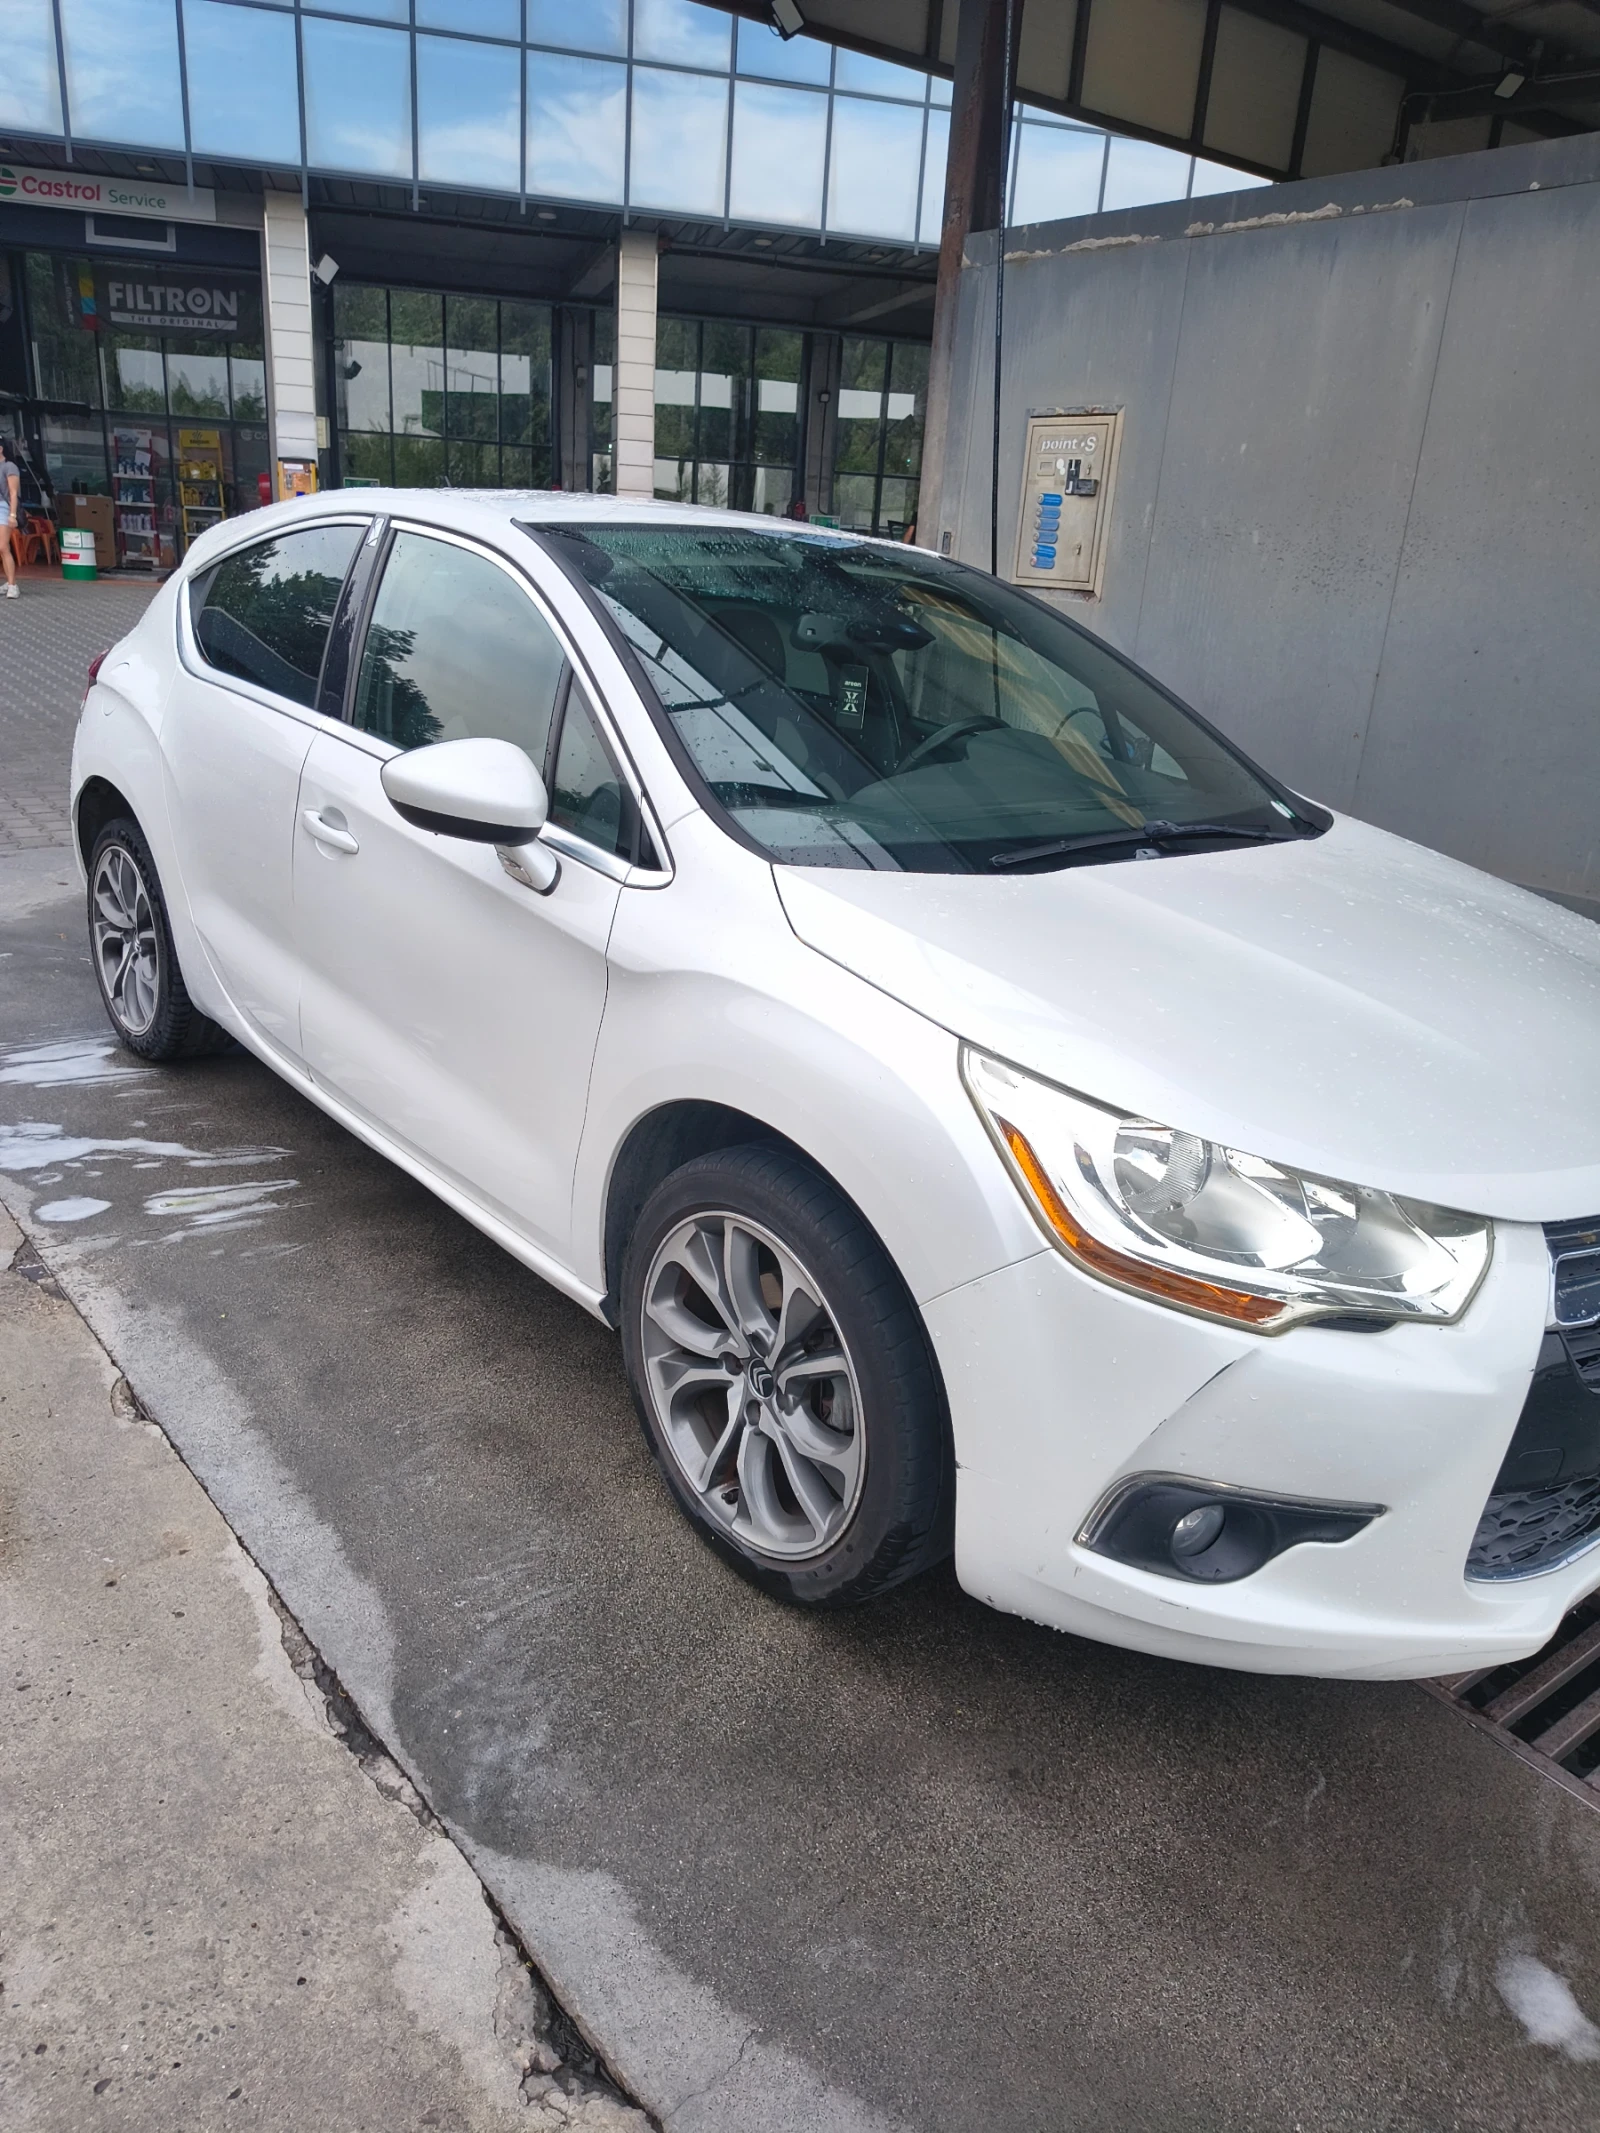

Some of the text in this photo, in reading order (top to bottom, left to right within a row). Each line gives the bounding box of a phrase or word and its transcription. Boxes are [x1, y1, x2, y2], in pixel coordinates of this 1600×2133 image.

[21, 175, 167, 209] Castrol Service
[108, 281, 238, 317] FILTRON
[130, 315, 220, 328] THE ORIGINAL
[1041, 438, 1077, 452] point
